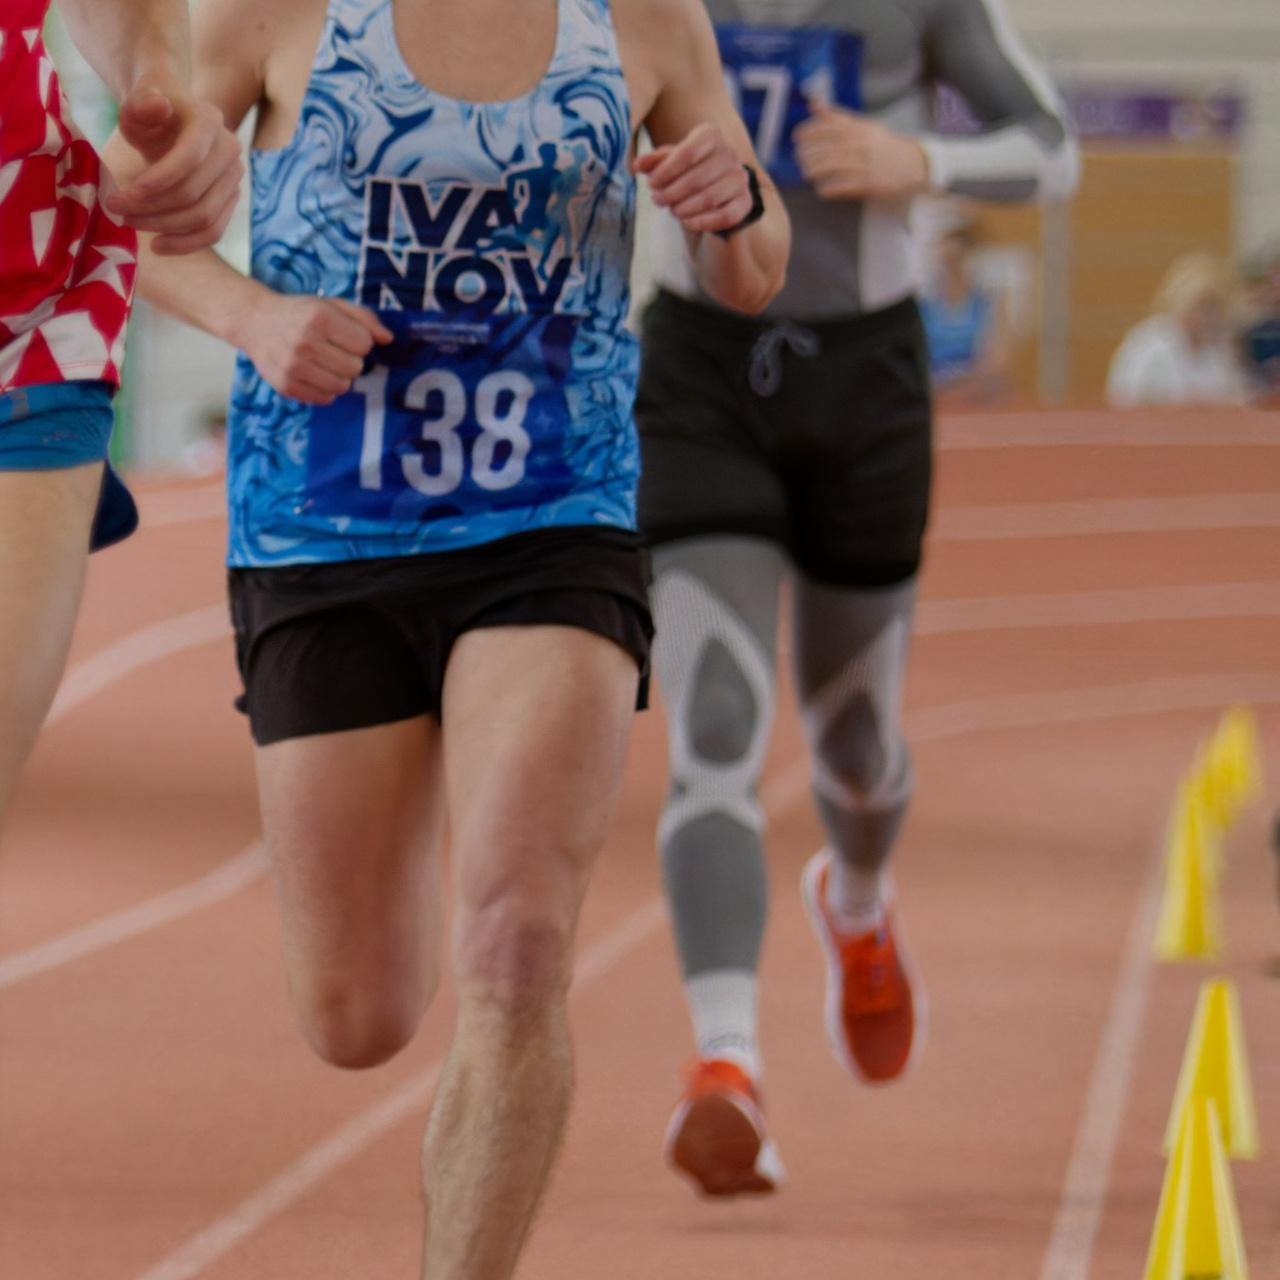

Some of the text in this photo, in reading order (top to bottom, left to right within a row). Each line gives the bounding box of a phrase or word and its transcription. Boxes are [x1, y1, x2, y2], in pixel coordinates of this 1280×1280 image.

[365, 178, 528, 252] IVA
[361, 247, 574, 314] NOV
[353, 365, 536, 497] 138
